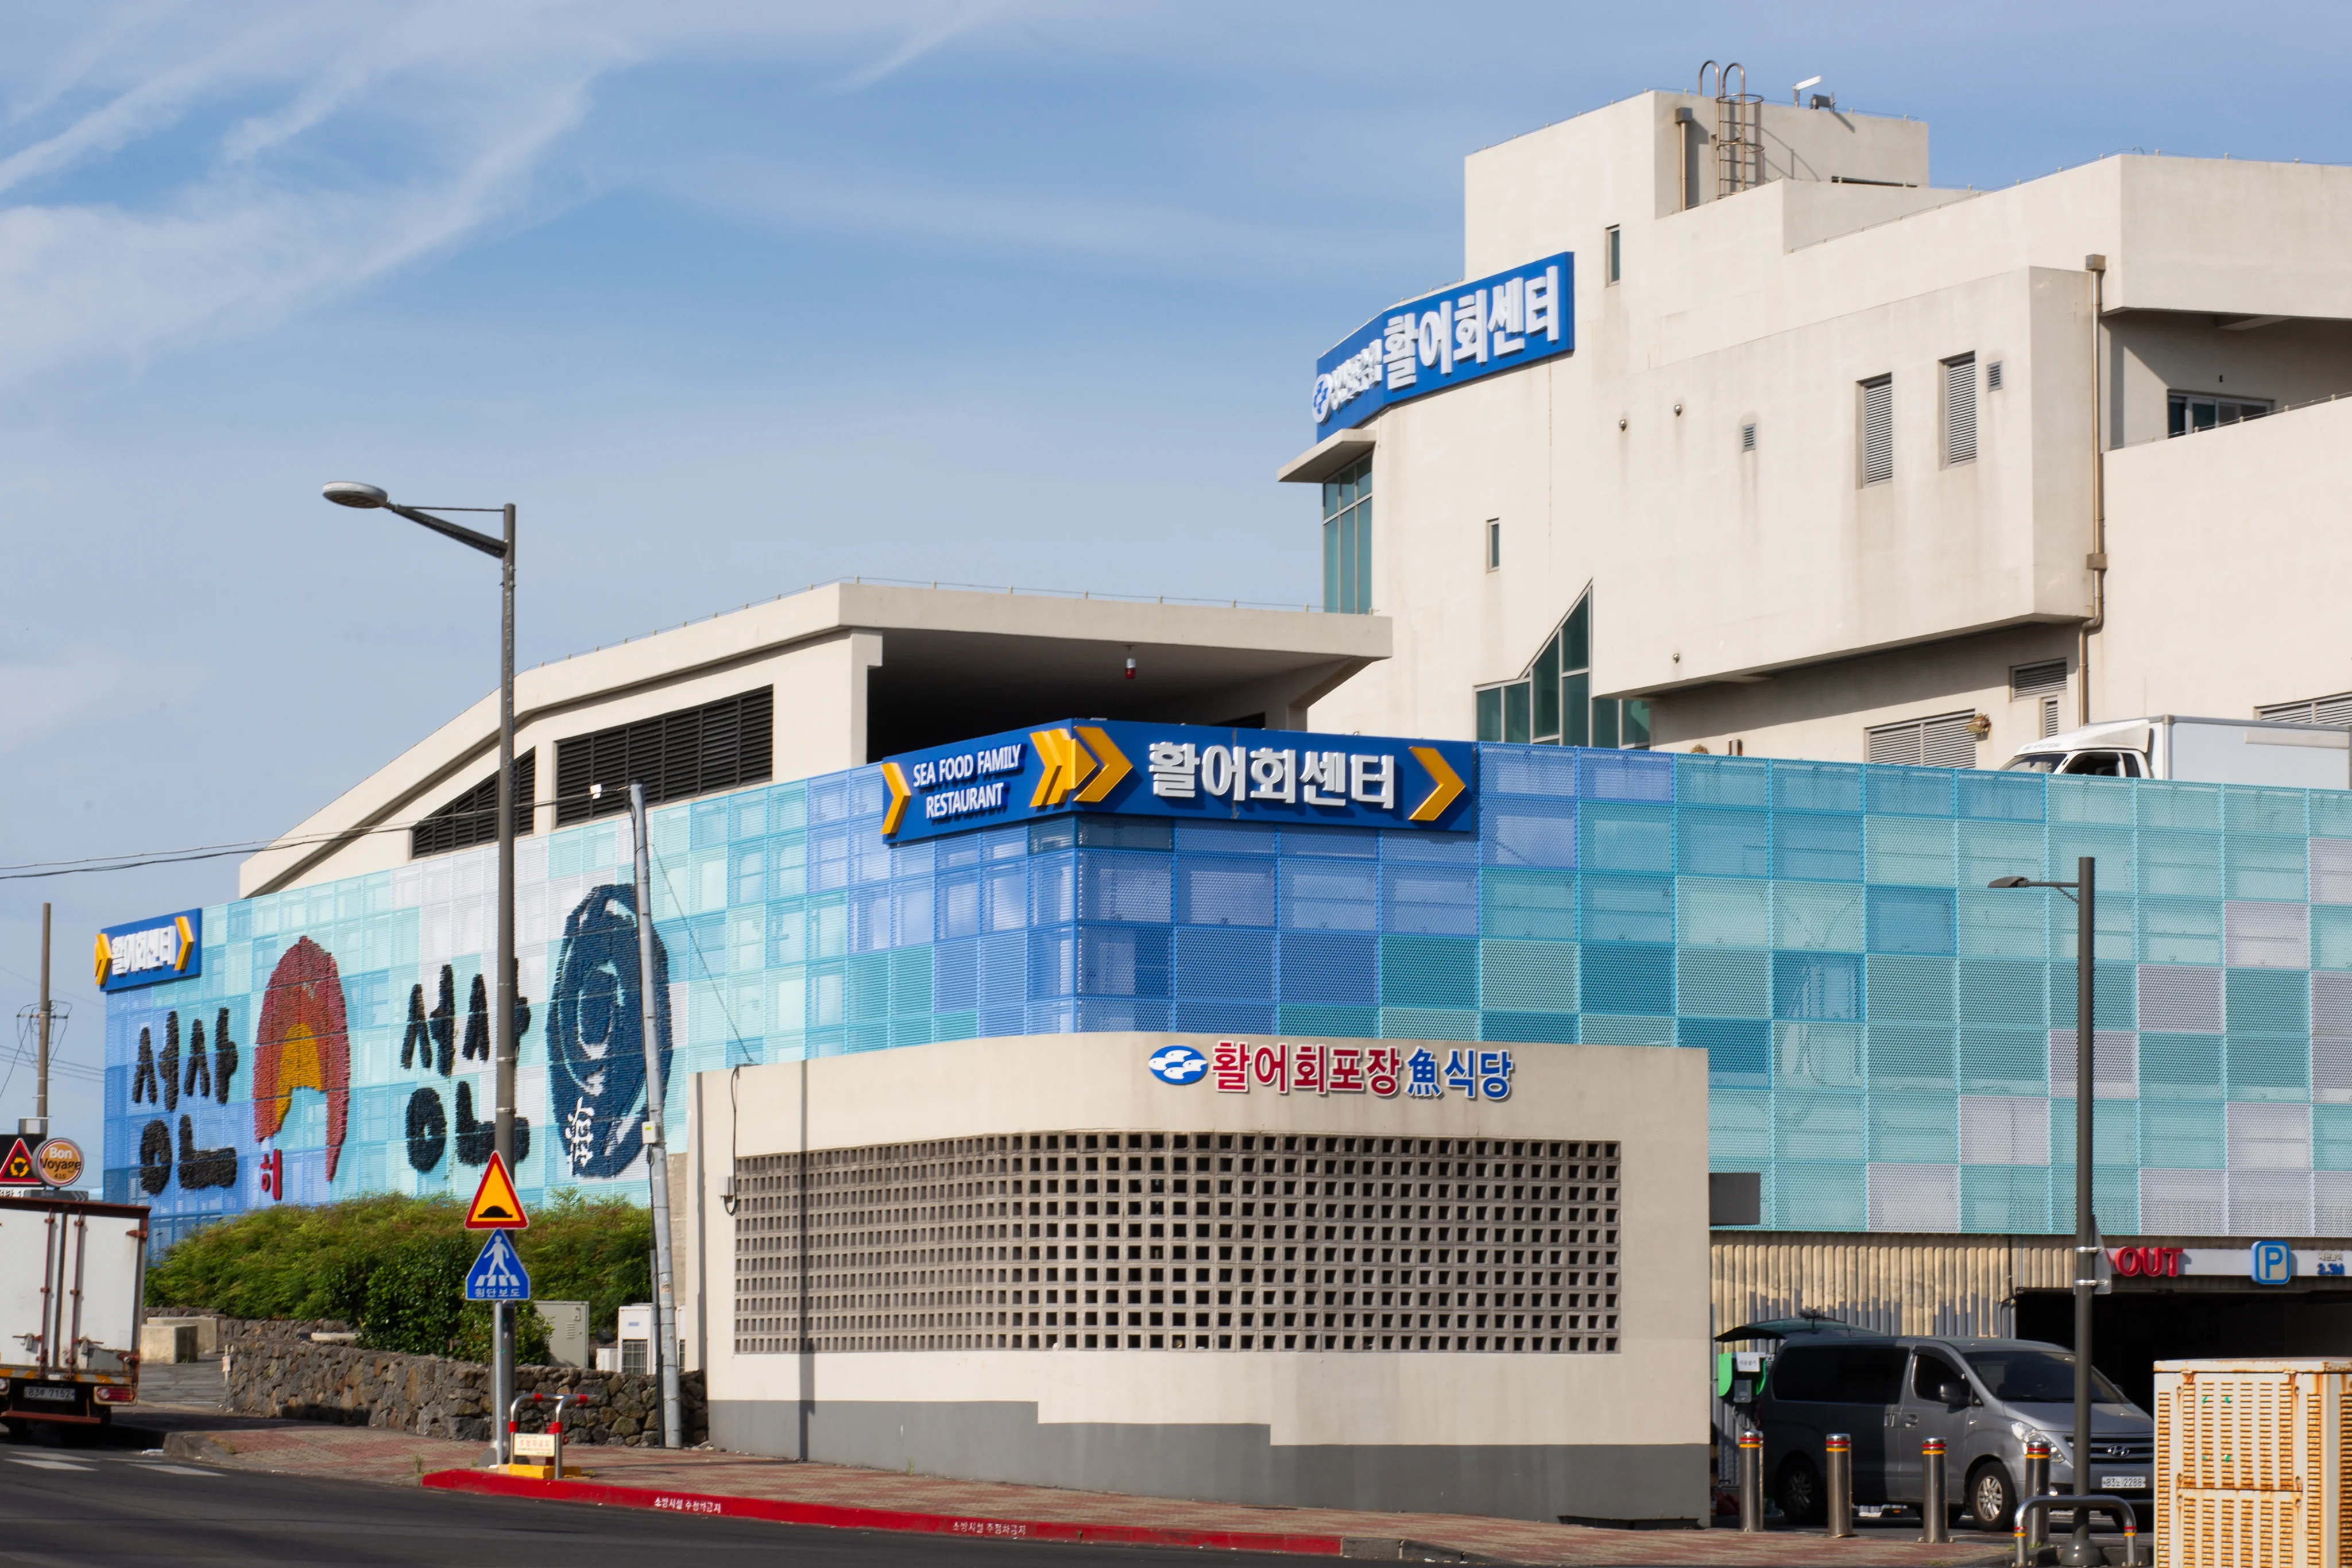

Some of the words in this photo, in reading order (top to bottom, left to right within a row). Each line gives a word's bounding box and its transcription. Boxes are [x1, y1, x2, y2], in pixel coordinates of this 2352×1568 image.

[1383, 266, 1559, 390] 활어회센터
[913, 761, 936, 787] SEA
[939, 754, 974, 782] FOOD
[977, 744, 1022, 775] FAMILY
[1149, 741, 1395, 810] 활어회센터
[926, 782, 1004, 819] RESTAURANT
[111, 925, 176, 975] 활어회센터
[41, 1158, 81, 1171] Voyage
[49, 1147, 72, 1159] Bon
[2114, 1246, 2184, 1277] OUT
[2264, 1246, 2283, 1279] P
[474, 1288, 521, 1298] 횡단보도
[655, 1497, 683, 1510] 소방시설
[953, 1521, 984, 1534] 소방시설
[987, 1522, 1026, 1536] 주정차금지
